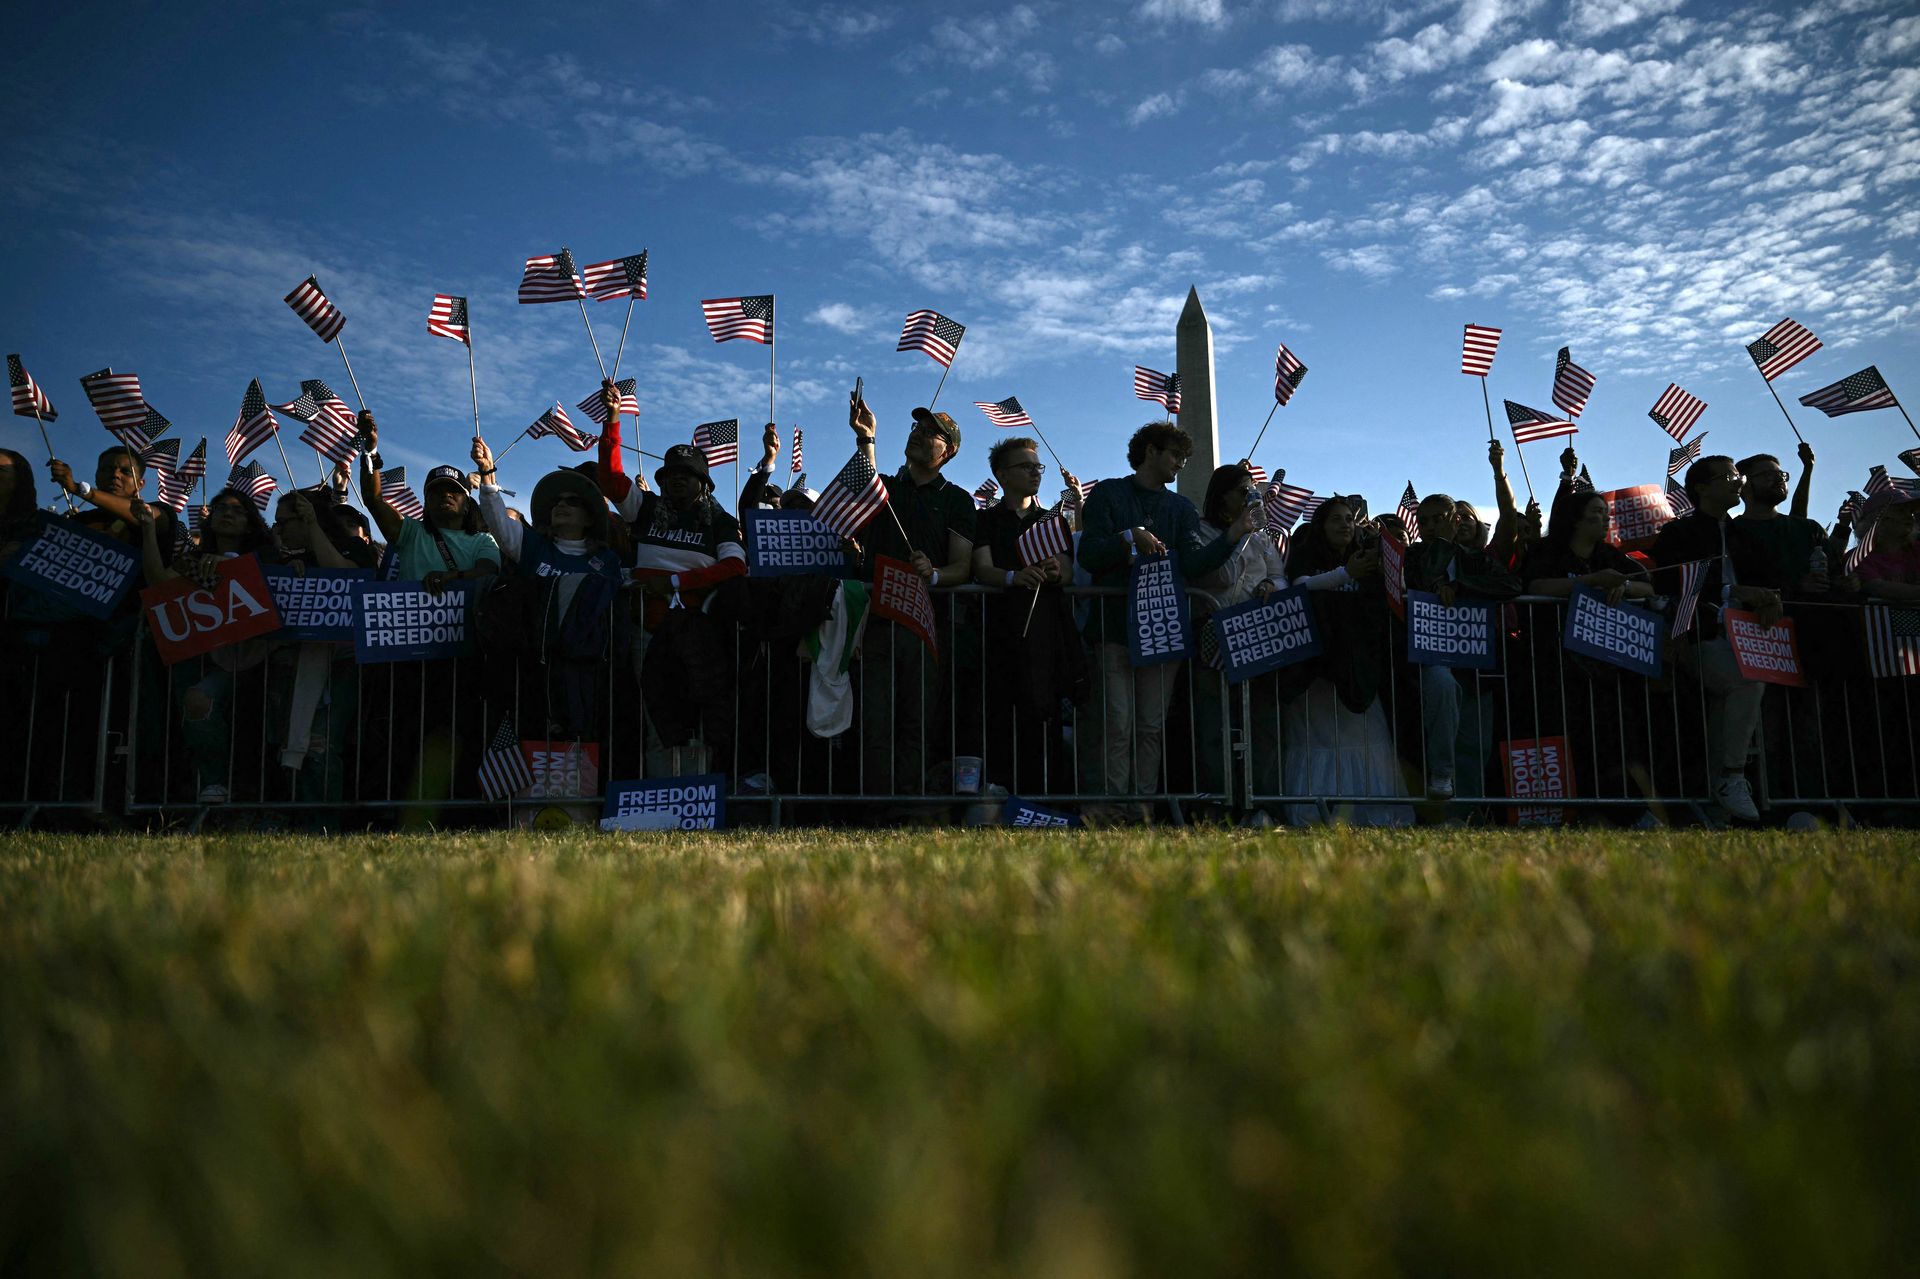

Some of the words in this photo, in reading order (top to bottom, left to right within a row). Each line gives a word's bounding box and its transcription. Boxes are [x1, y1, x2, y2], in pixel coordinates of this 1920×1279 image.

[43, 523, 134, 573] FREEDOM
[647, 521, 705, 545] HOWARD
[1610, 519, 1665, 543] FREEDO
[31, 538, 126, 588] FREEDOM
[758, 551, 845, 566] FREEDOM
[19, 553, 116, 604] FREEDOM
[150, 579, 269, 641] USA
[363, 591, 465, 610] FREEDOM
[365, 608, 464, 628] FREEDOM
[1137, 564, 1155, 656] FREEDOM
[1148, 562, 1170, 654] FREEDOM
[1160, 560, 1185, 652] FREEDOM
[1222, 596, 1304, 635] FREEDOM
[1413, 600, 1488, 622] FREEDOM
[1577, 593, 1655, 636] FREEDOM
[366, 626, 464, 647] FREEDOM
[1226, 611, 1308, 651] FREEDOM
[1413, 617, 1487, 639] FREEDOM
[1414, 634, 1487, 655] FREEDOM
[1573, 624, 1655, 665] FREEDOM
[1575, 609, 1655, 650] FREEDOM
[1735, 635, 1794, 658] FREEDOM
[1231, 628, 1312, 668] FREEDOM
[1740, 652, 1799, 674] FREEDOM
[618, 785, 716, 807] FREEDOM
